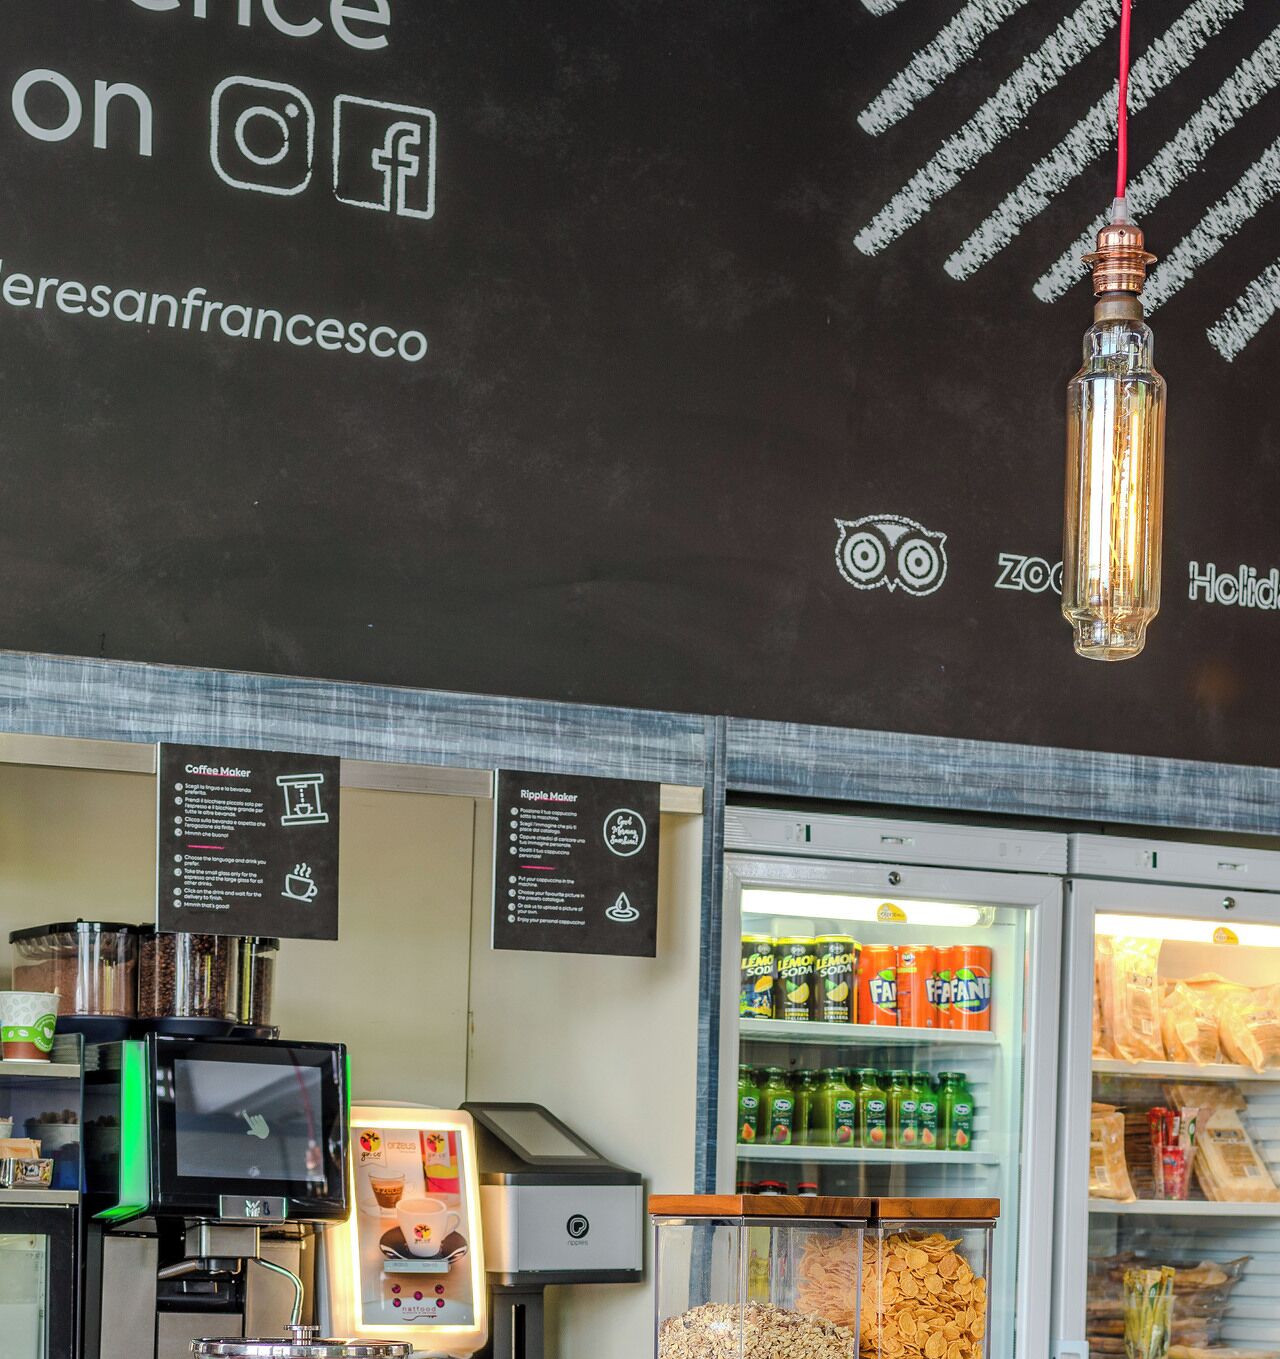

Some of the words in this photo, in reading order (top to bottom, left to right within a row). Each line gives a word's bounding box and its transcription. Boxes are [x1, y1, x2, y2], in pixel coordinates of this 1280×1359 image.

[12, 67, 152, 156] on
[185, 764, 218, 775] Coffee
[220, 766, 251, 778] Maker
[520, 790, 548, 802] Ripple
[550, 792, 578, 802] Maker
[741, 954, 774, 970] LEMO
[820, 964, 852, 977] SODA
[950, 977, 990, 1003] FANT
